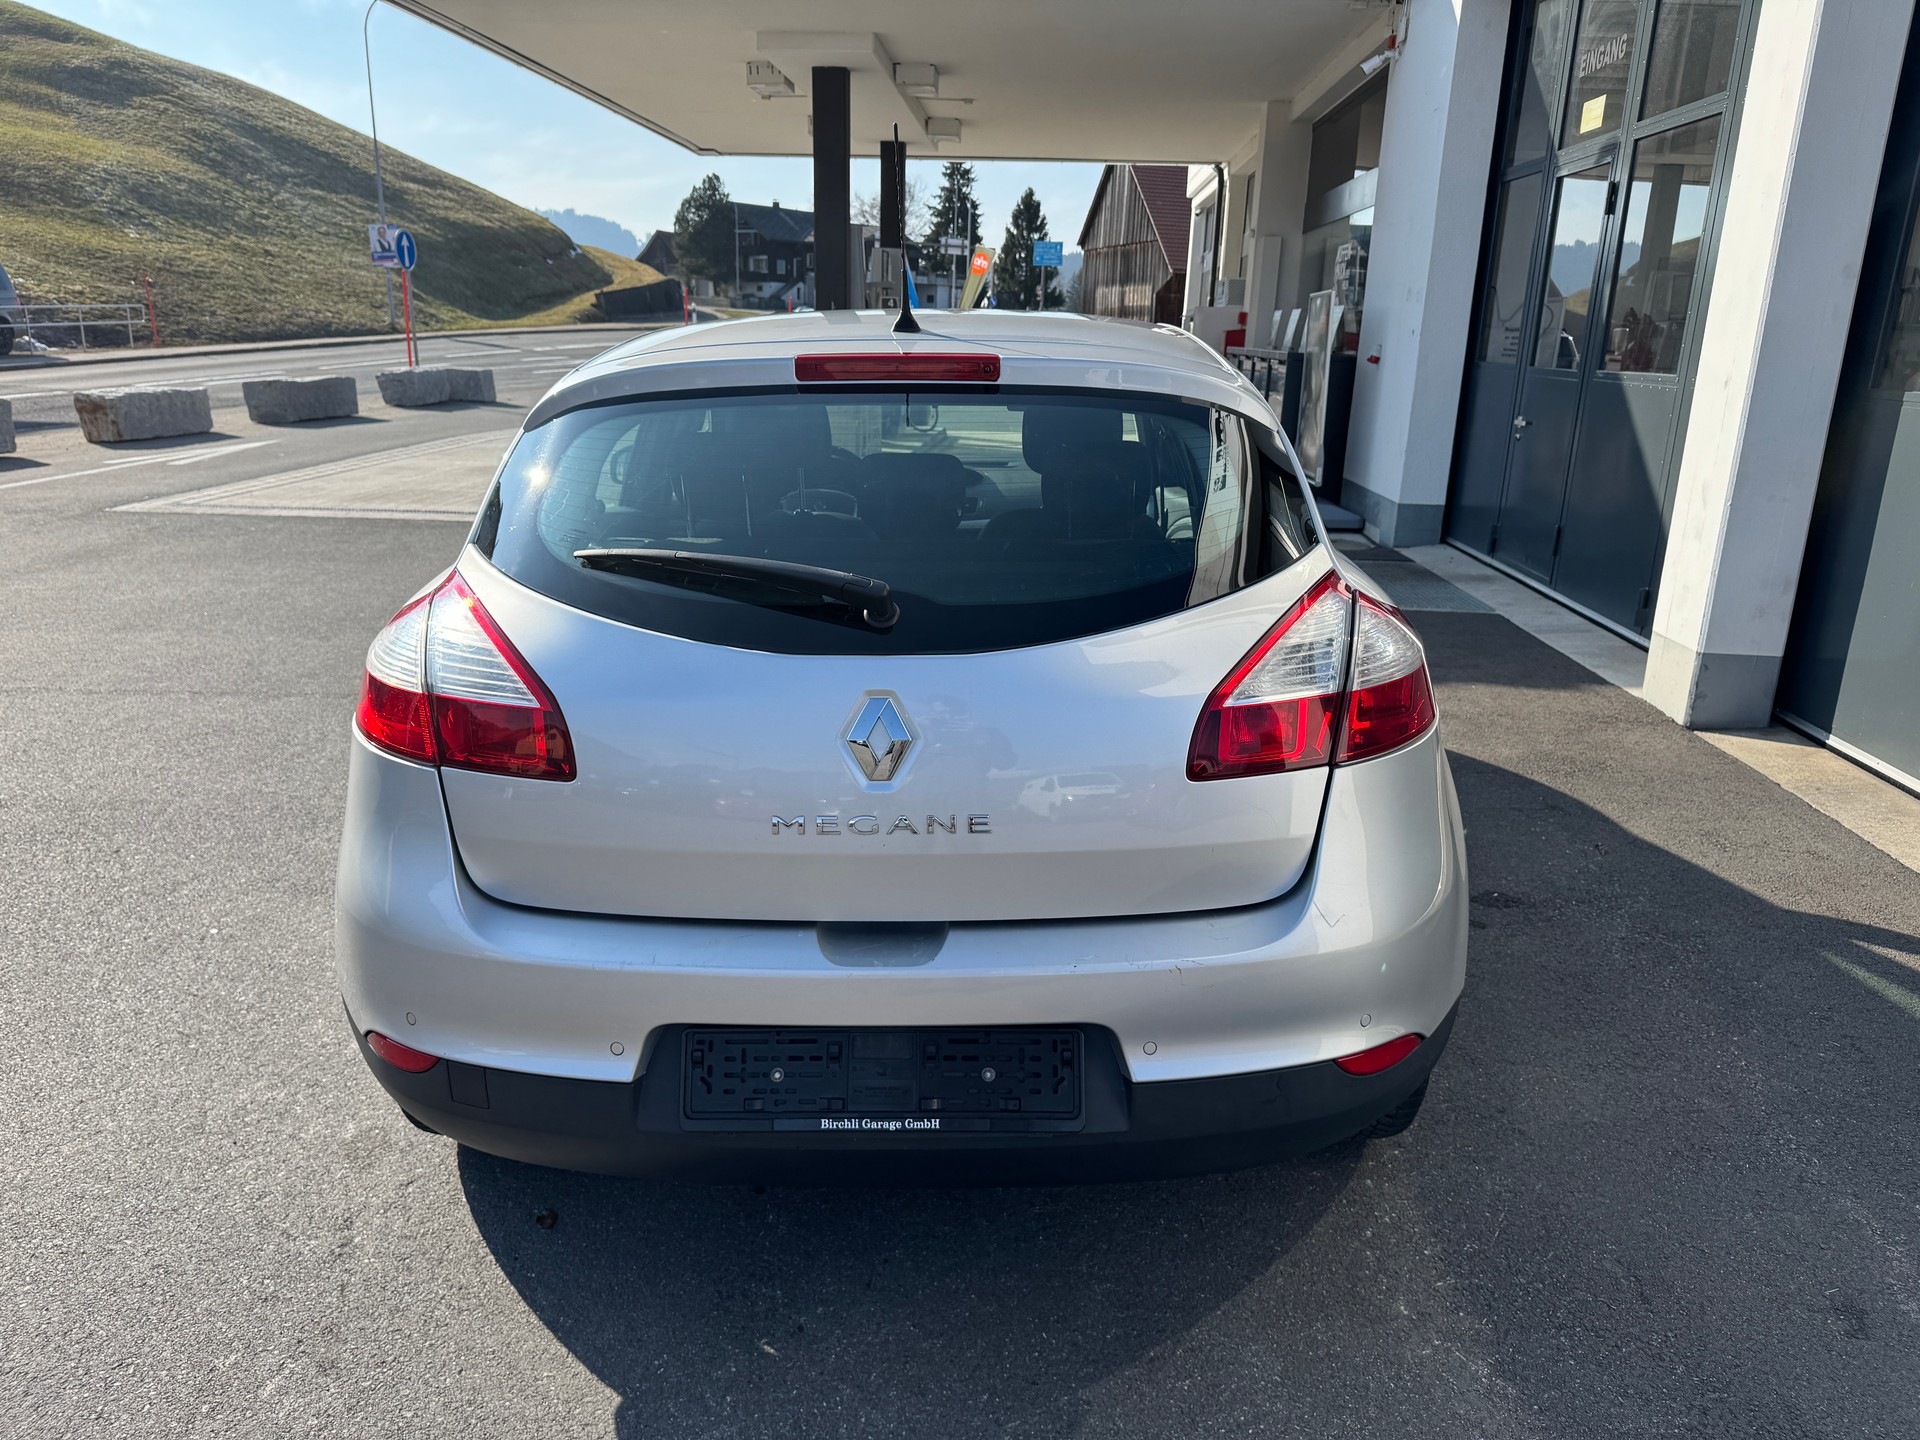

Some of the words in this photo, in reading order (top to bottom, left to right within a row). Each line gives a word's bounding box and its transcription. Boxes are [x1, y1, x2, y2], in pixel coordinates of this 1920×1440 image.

[1579, 33, 1628, 78] EINGANG
[887, 298, 894, 308] 4
[771, 814, 993, 836] MEGANE
[820, 1118, 859, 1129] Birchli
[862, 1118, 902, 1131] Garage
[904, 1118, 940, 1129] GmbH
